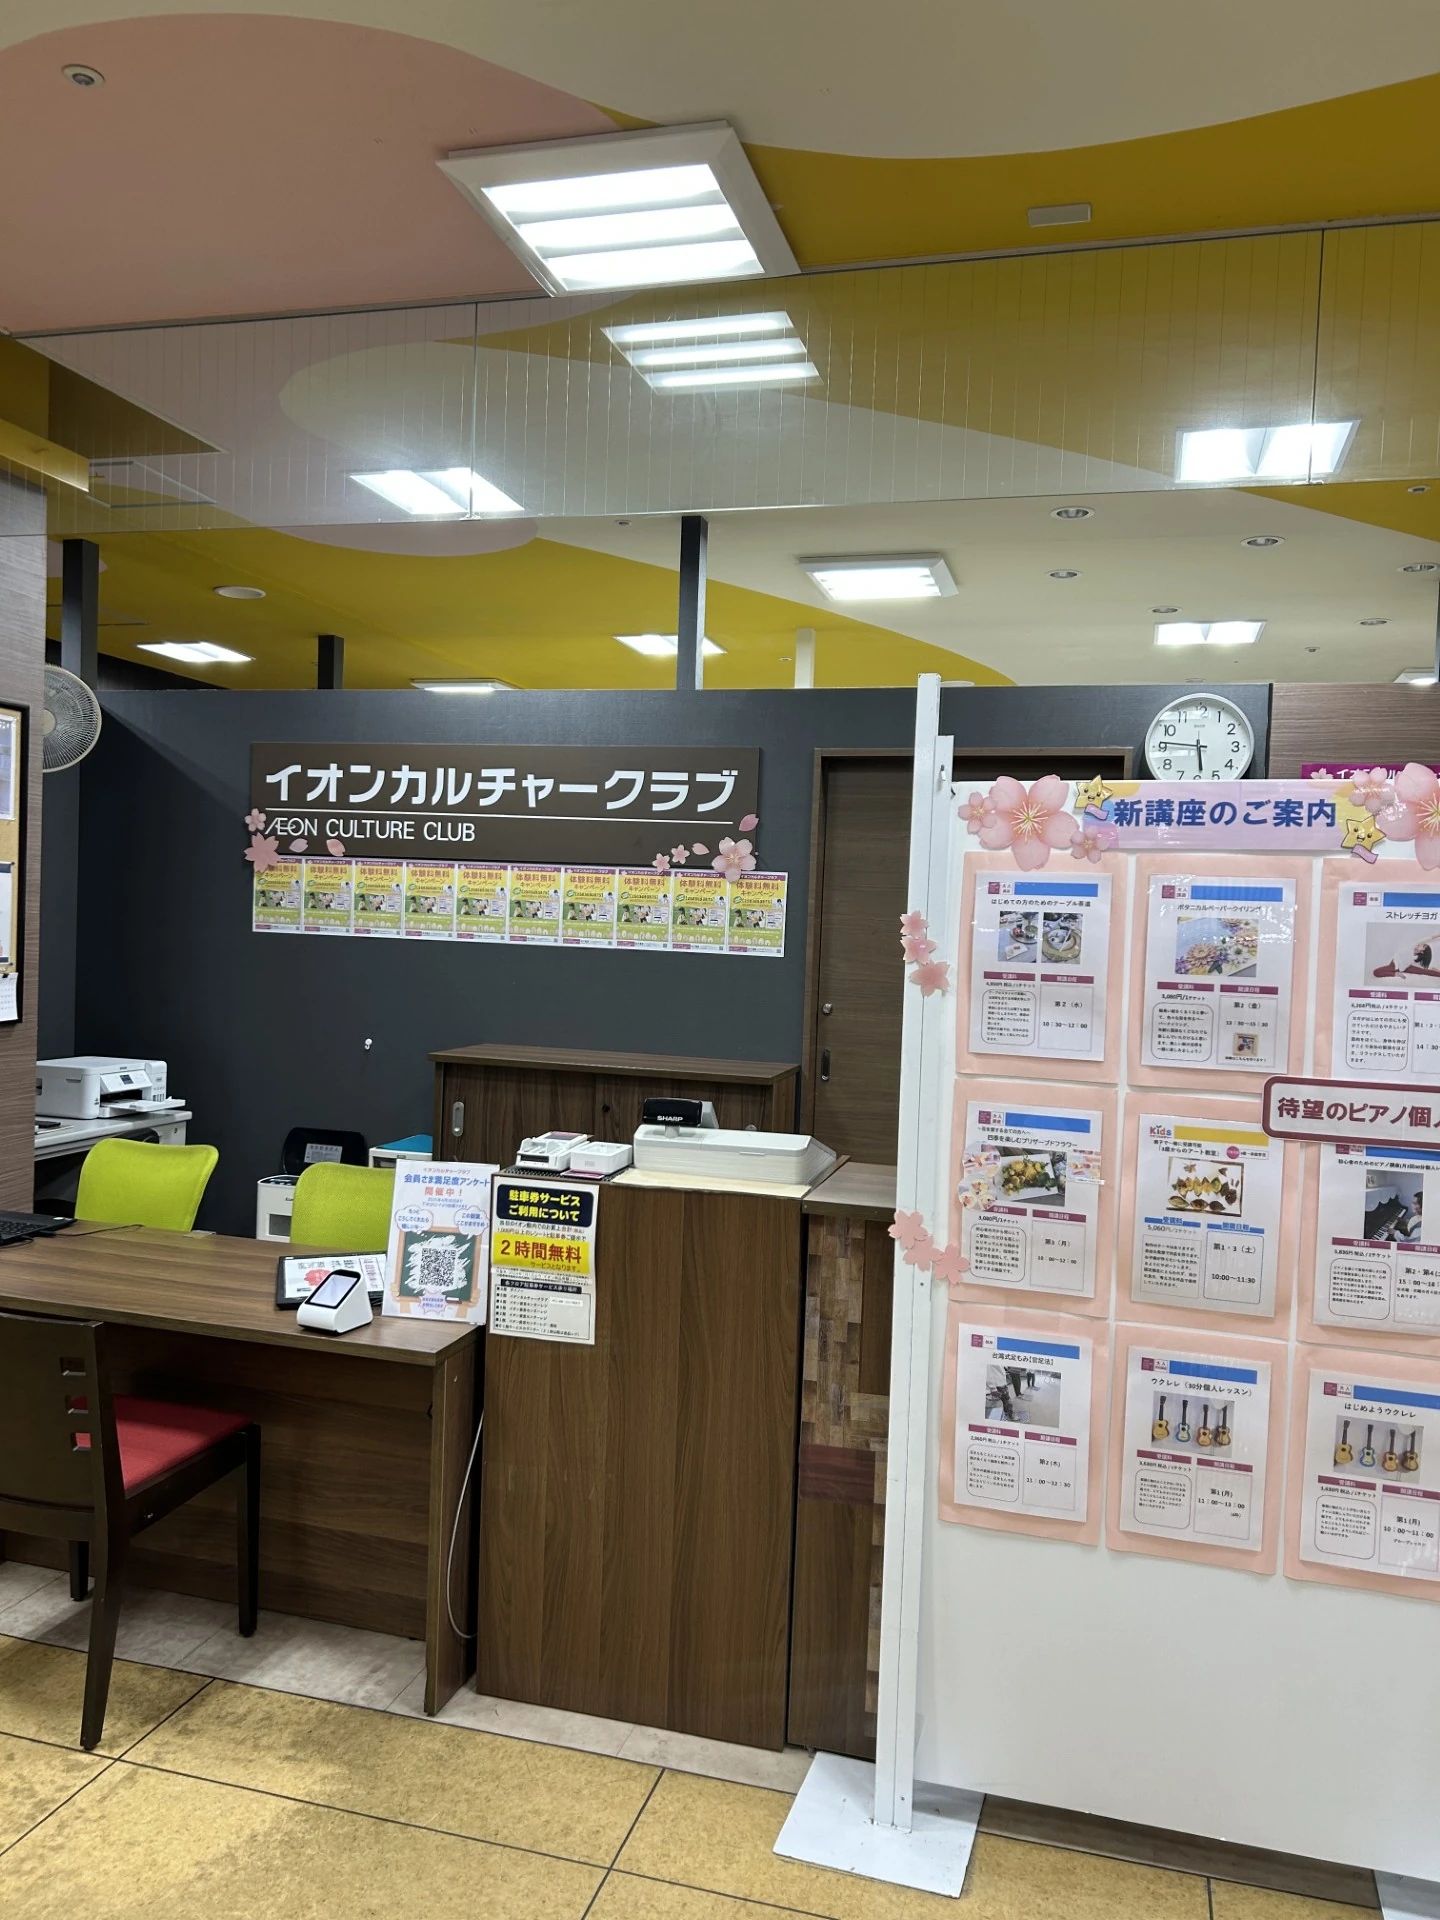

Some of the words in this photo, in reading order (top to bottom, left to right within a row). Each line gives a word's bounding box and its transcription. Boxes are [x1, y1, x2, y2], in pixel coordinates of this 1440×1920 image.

[1178, 711, 1188, 723] 11
[1217, 711, 1222, 723] 1
[1164, 724, 1176, 737] 10
[1227, 723, 1236, 735] 2
[1158, 742, 1168, 753] 9
[1231, 741, 1240, 753] 3
[1163, 758, 1172, 770] 8
[1224, 759, 1234, 770] 4
[1177, 770, 1185, 781] 7
[265, 762, 740, 813] イオンカルチャークラブ
[1113, 798, 1337, 829] 新講座のご案内
[325, 818, 415, 840] CULTURE
[423, 822, 476, 843] CLUB
[267, 864, 297, 873] 験料無料
[310, 865, 347, 874] 体験料無料
[360, 867, 397, 876] 体験料無料
[411, 870, 450, 878] 体験料無料
[364, 875, 394, 883] キャンペーン
[463, 871, 502, 880] 体験料無料
[516, 873, 556, 882] 体験料無料
[570, 876, 610, 885] 体験料無料
[624, 877, 665, 886] 体験料無料
[680, 880, 722, 888] 体験料無料
[736, 882, 779, 891] 体験料無料
[741, 890, 775, 898] キャンペーン
[1385, 911, 1438, 920] ストレッチヨガ
[1149, 1125, 1172, 1136] Kids
[404, 1173, 491, 1187] 会員さま満足度アンケート
[424, 1186, 463, 1196] 開催中！
[508, 1189, 581, 1207] 駐車券サービス
[508, 1204, 580, 1222] ご利用について
[1344, 1402, 1417, 1418] はじめようウクレレ
